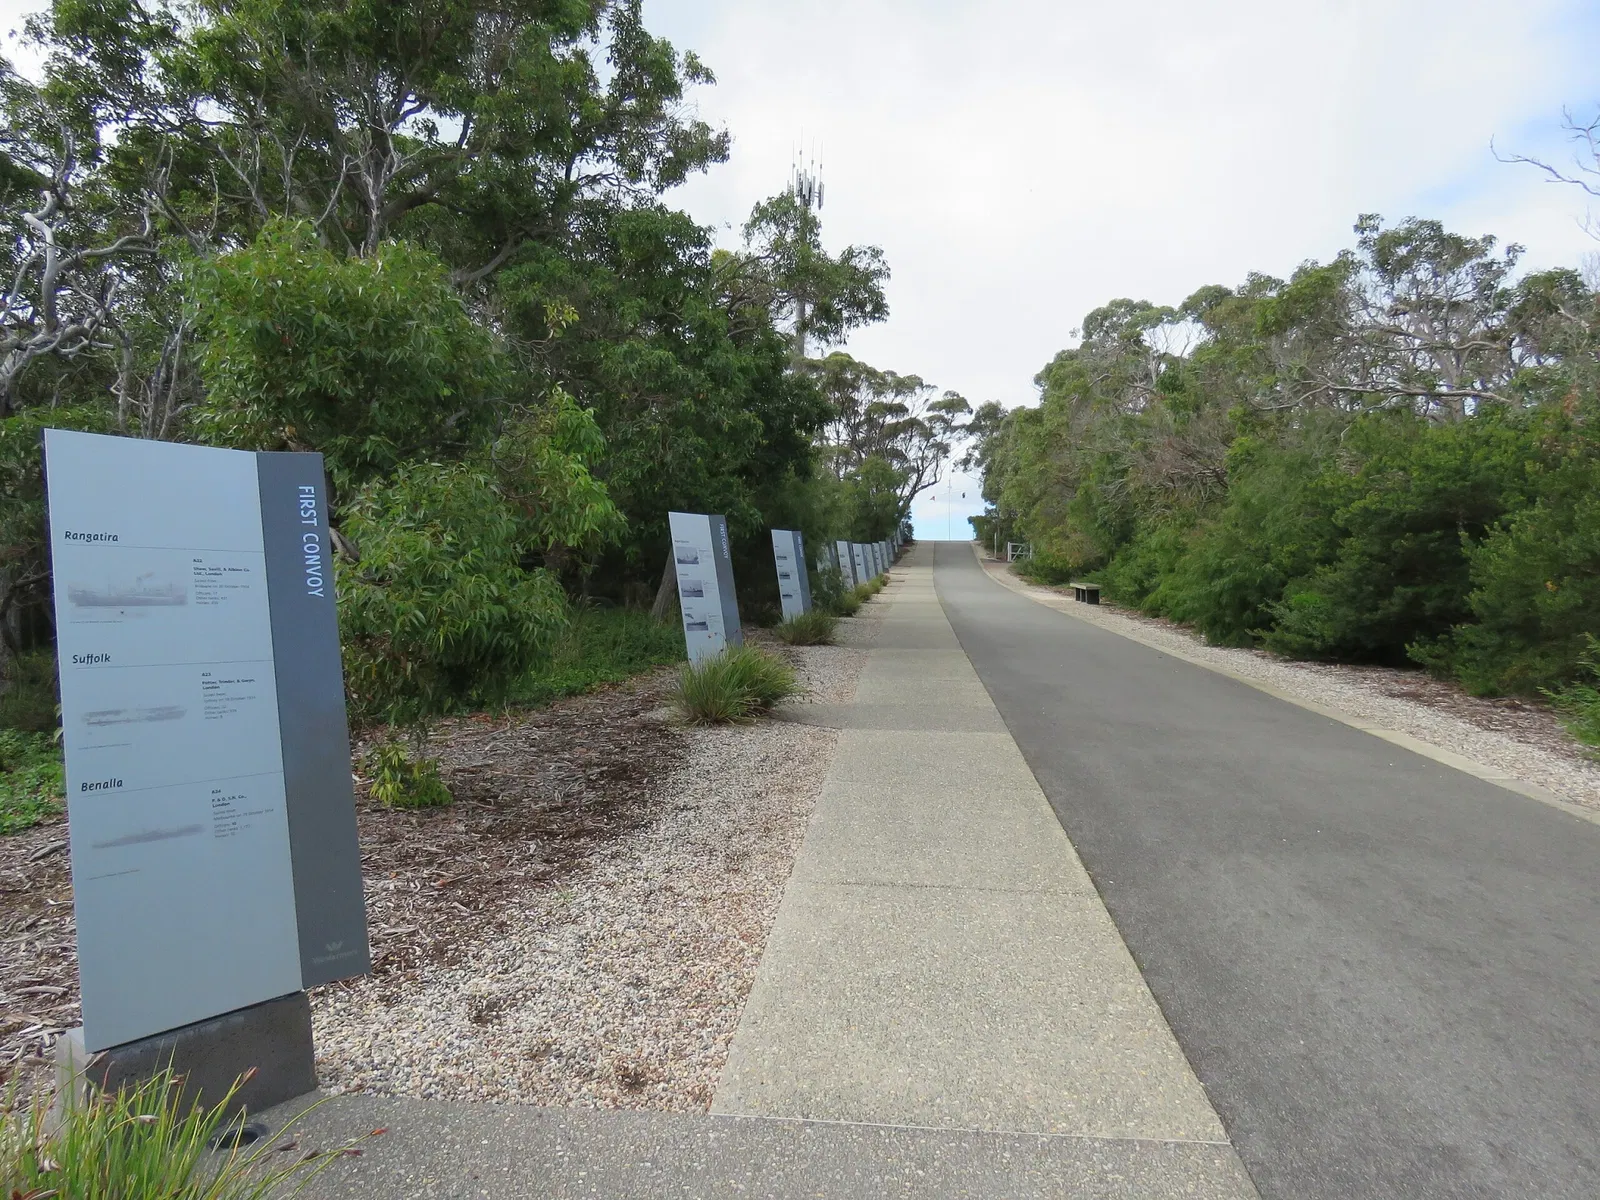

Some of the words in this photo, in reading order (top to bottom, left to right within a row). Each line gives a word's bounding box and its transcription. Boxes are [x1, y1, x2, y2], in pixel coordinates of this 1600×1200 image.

[298, 486, 318, 527] FIRST
[64, 530, 120, 543] Rangatira
[302, 533, 325, 598] CONVOY
[72, 653, 111, 665] Suffolk
[81, 778, 123, 792] Benalla
